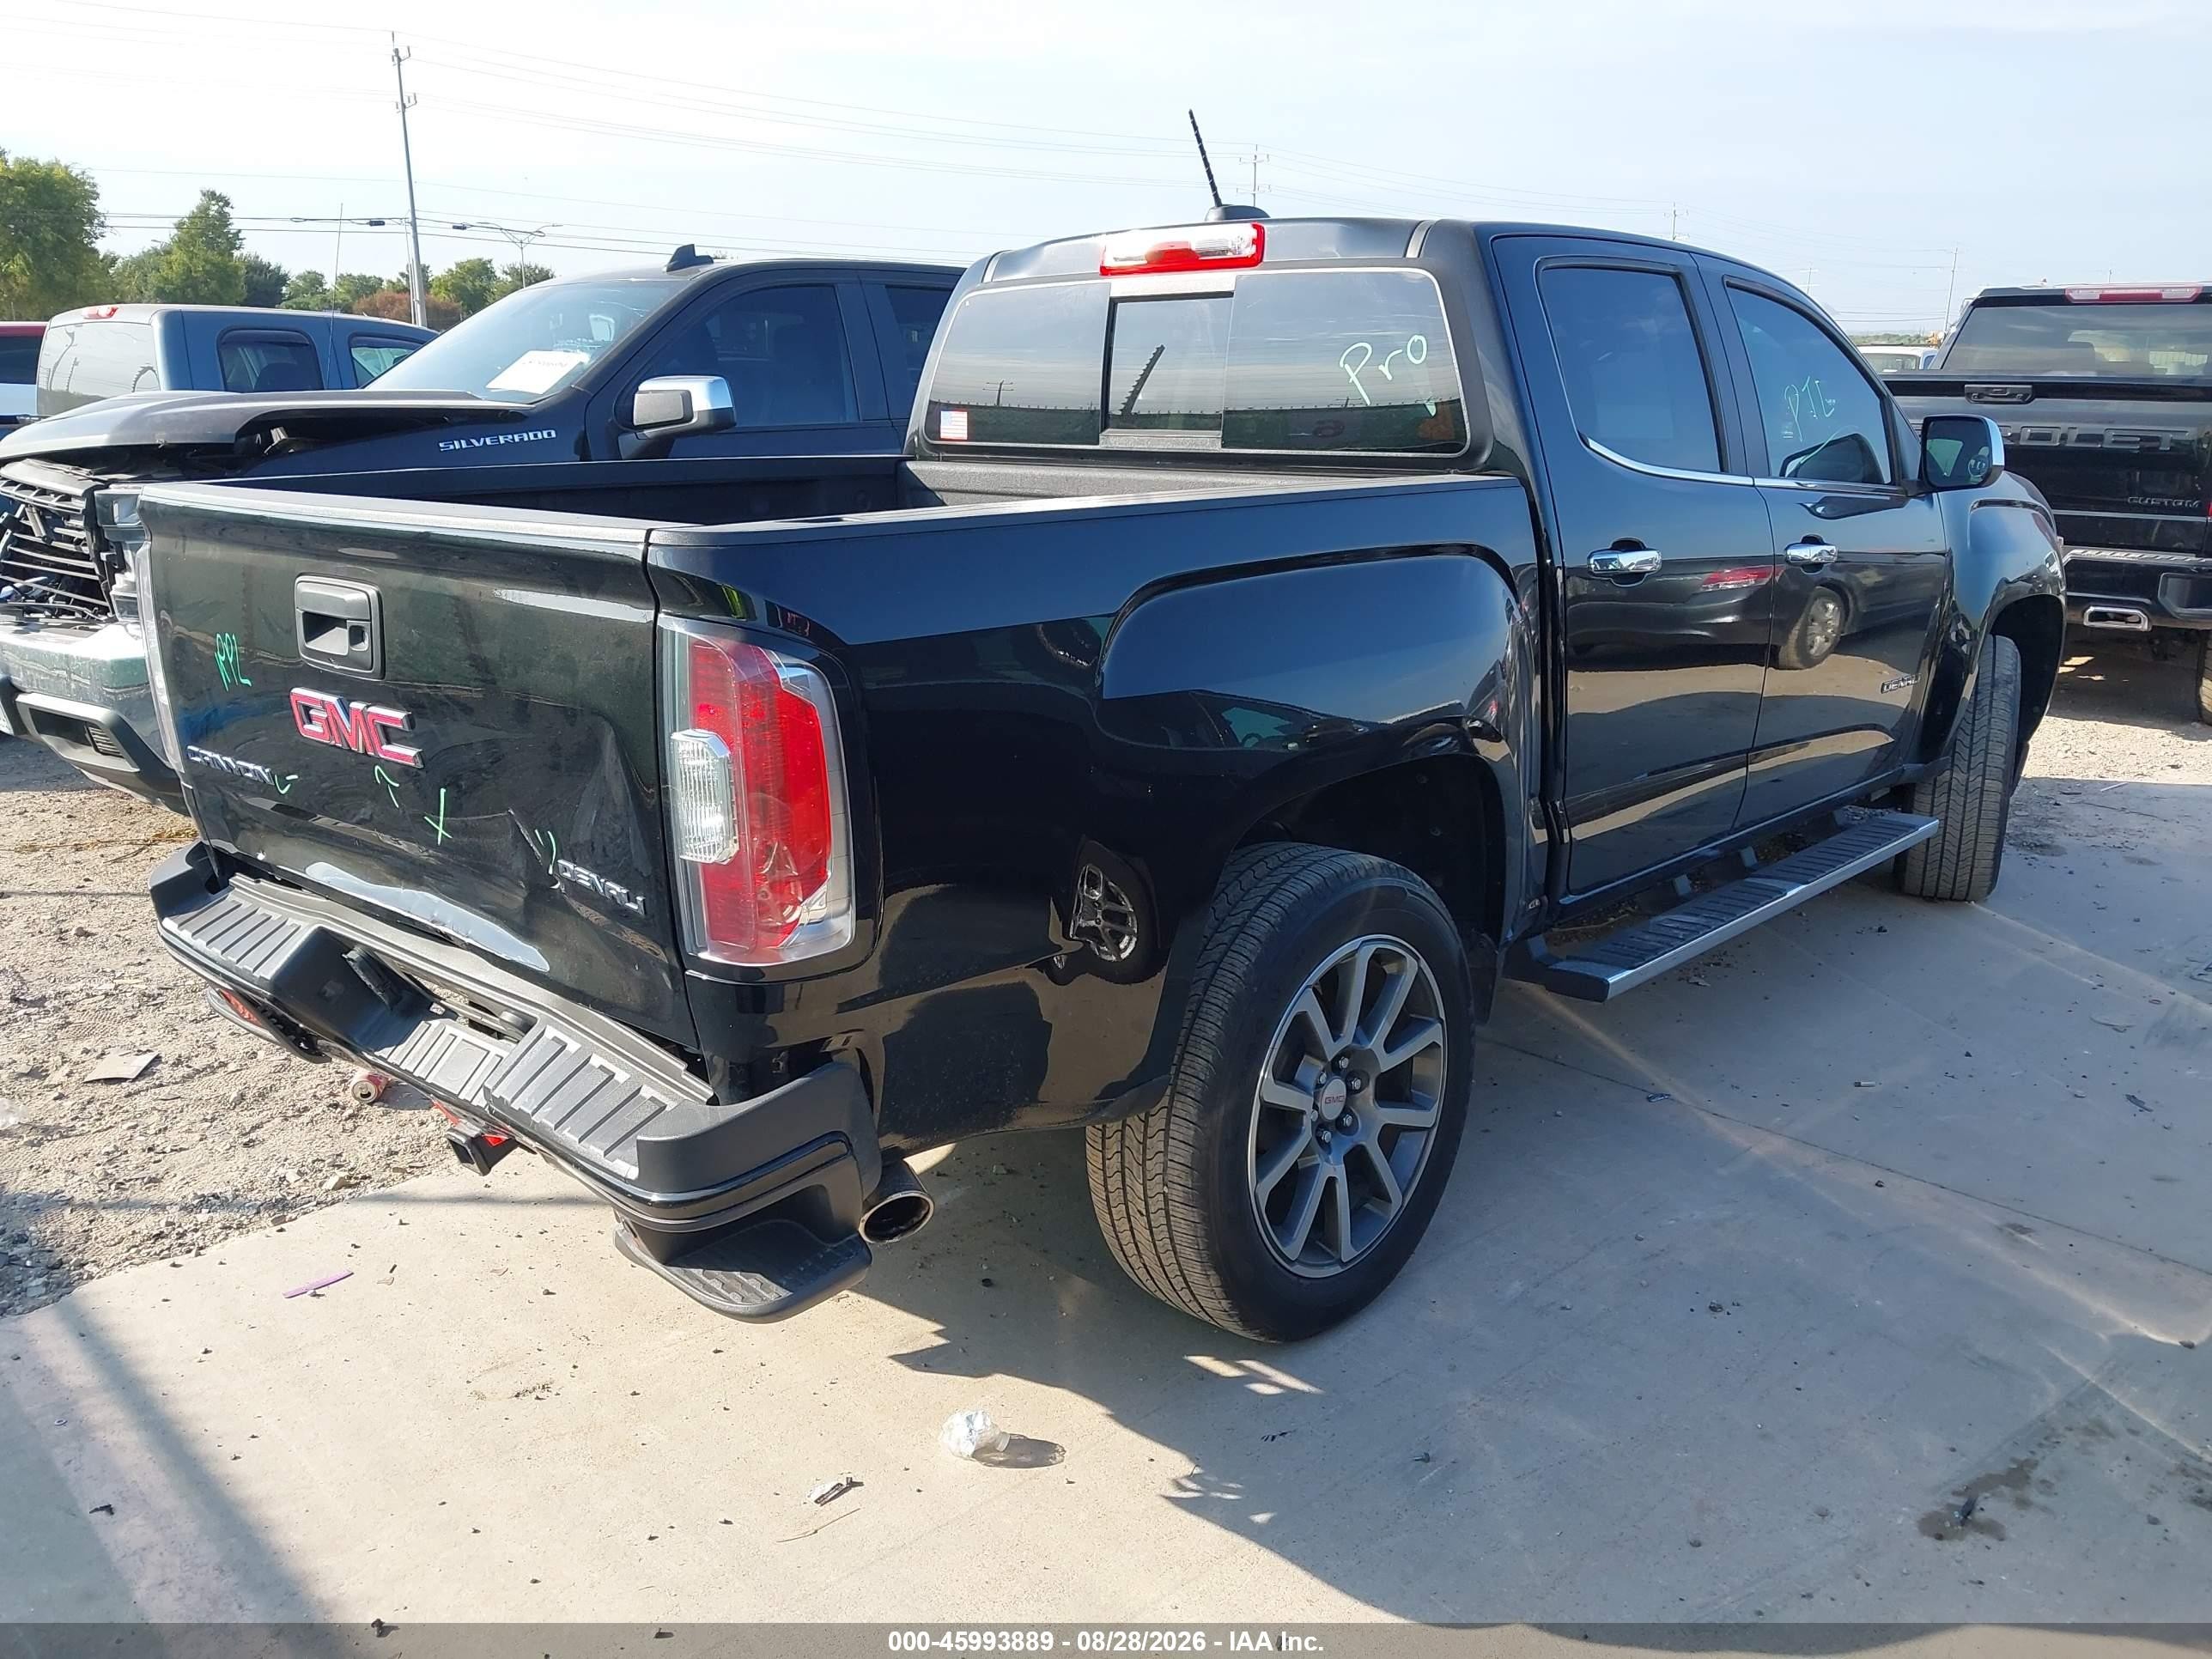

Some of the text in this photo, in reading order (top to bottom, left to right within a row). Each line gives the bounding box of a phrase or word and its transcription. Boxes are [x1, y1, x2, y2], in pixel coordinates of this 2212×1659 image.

[1340, 334, 1427, 406] Pro
[438, 428, 557, 452] SILVERADO
[2127, 496, 2202, 508] CUSTOM
[1881, 672, 1923, 694] DENALI
[289, 686, 426, 769] GMC
[186, 744, 276, 787] CANYON
[557, 859, 647, 918] DENALI
[1324, 1095, 1346, 1105] GMC
